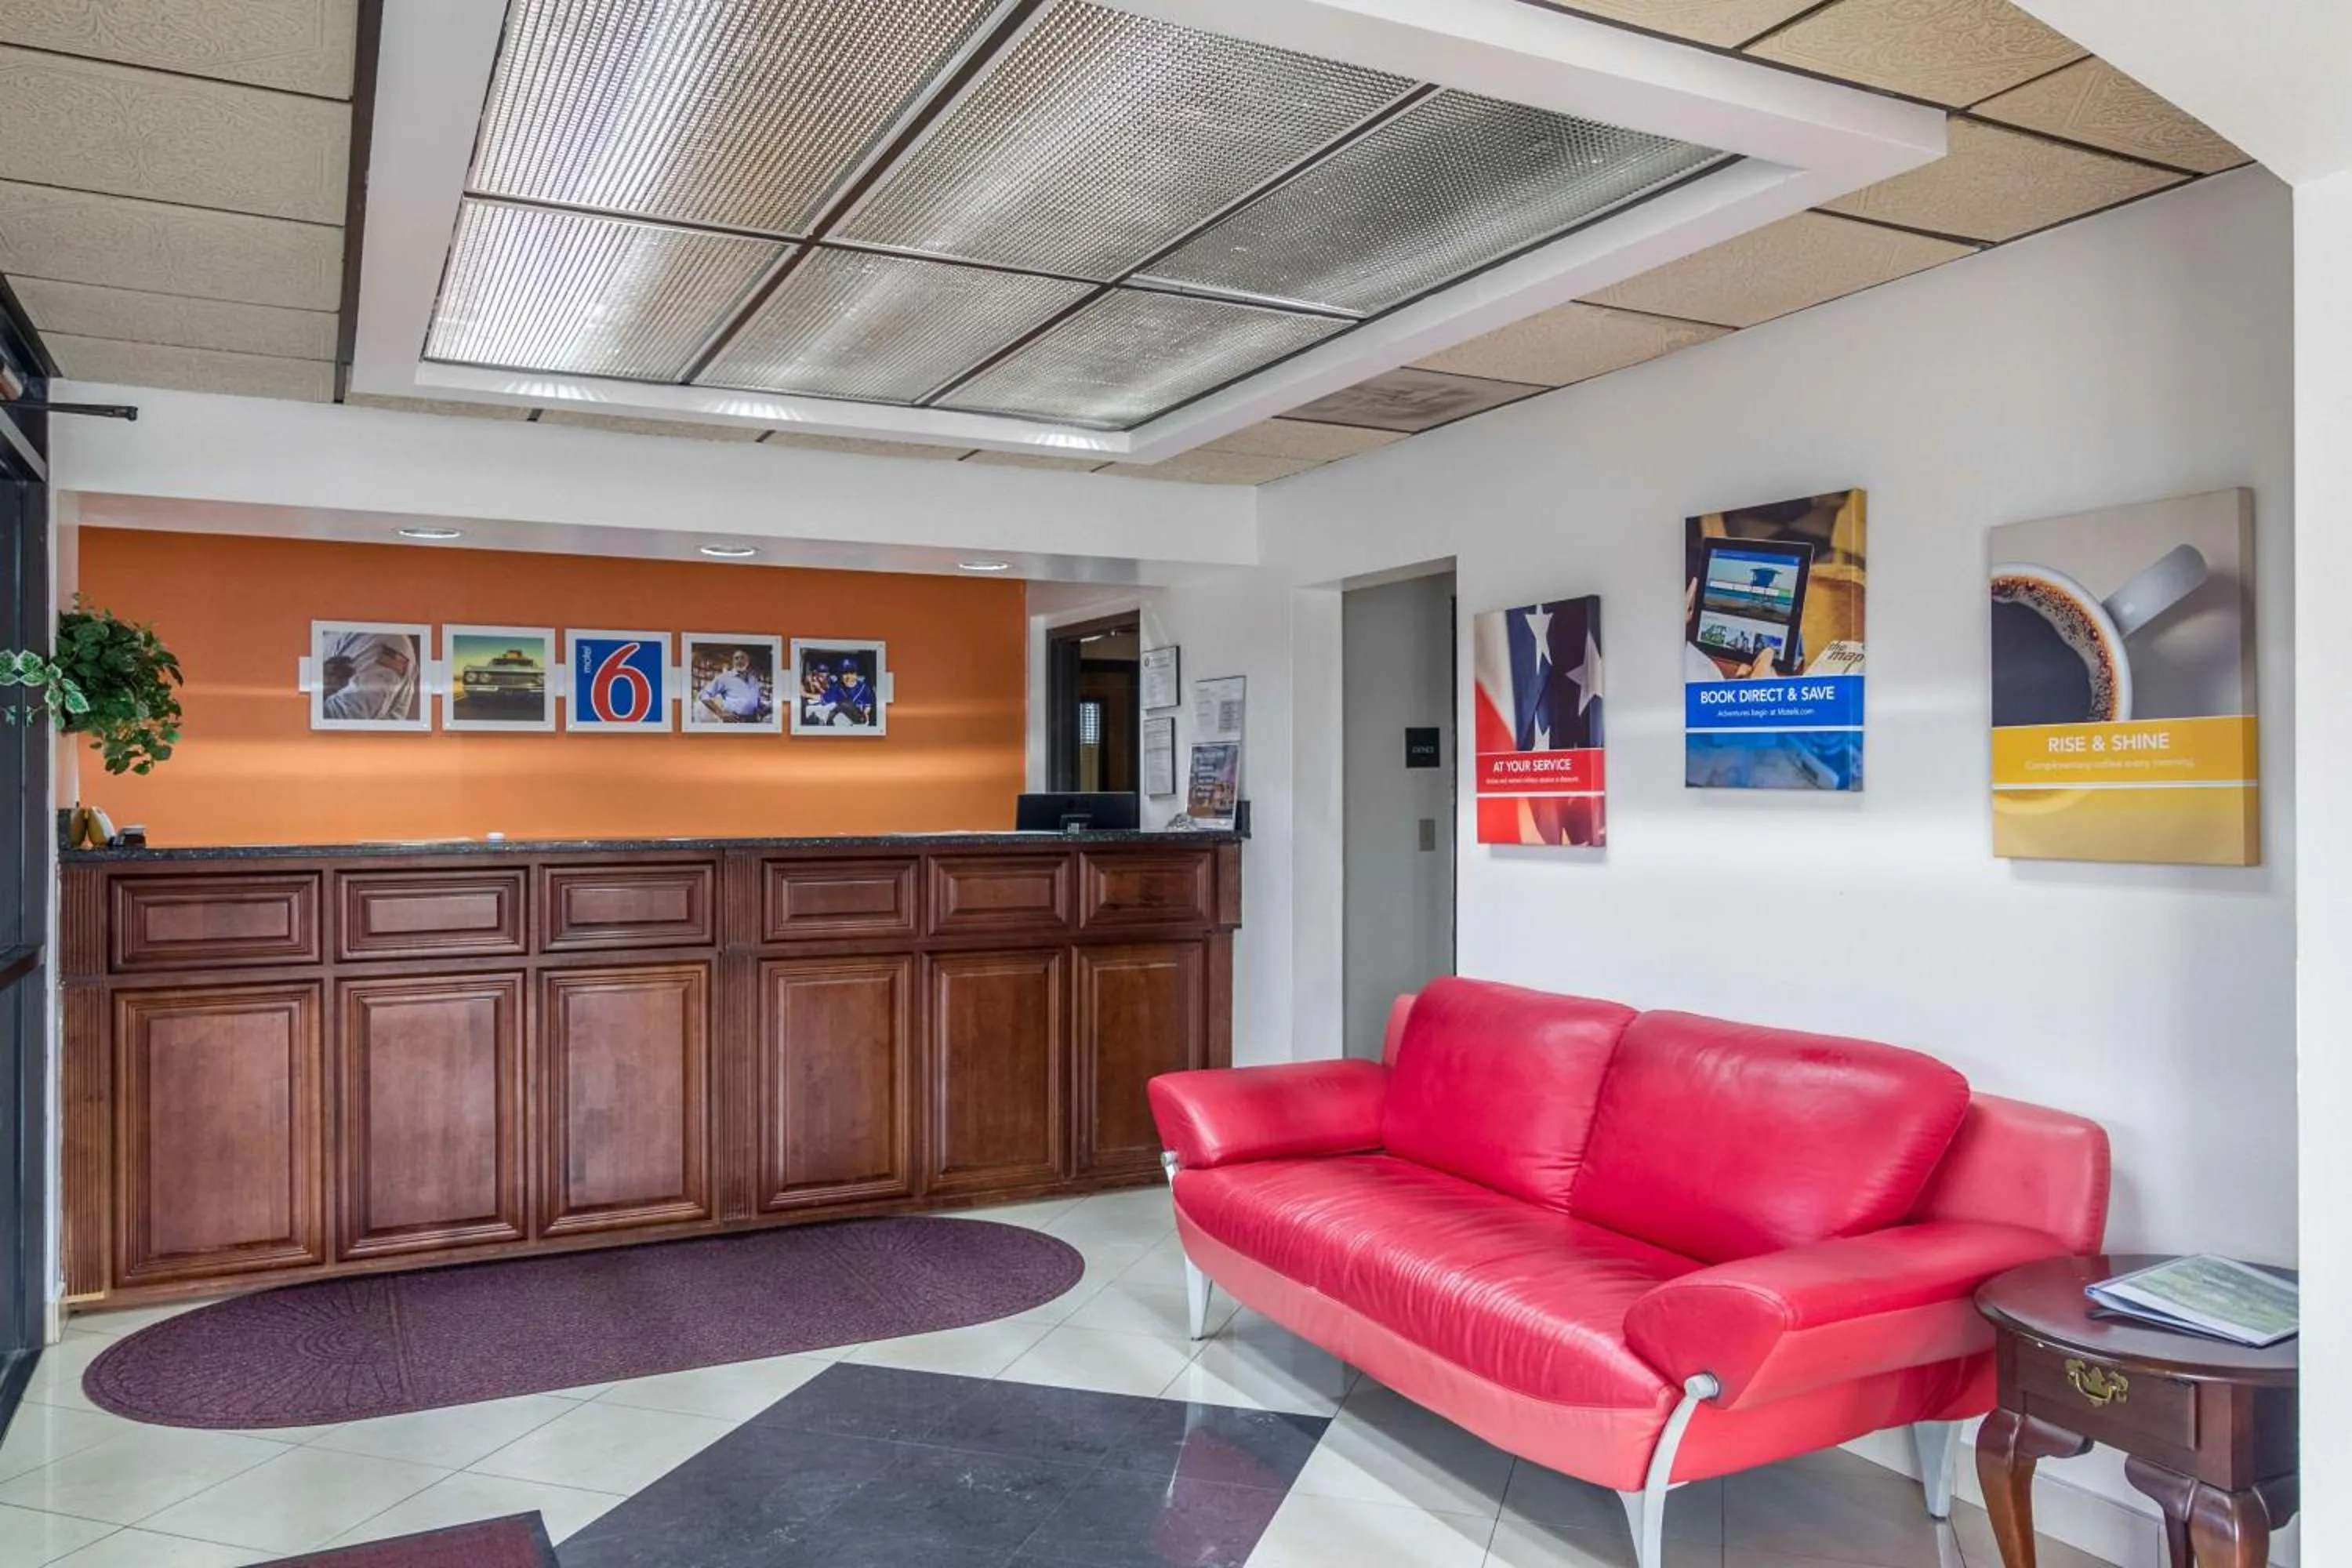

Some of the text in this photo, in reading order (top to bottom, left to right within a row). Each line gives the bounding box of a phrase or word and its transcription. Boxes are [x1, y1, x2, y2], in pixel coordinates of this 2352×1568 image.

[582, 645, 592, 673] motel
[1828, 652, 1864, 673] map
[591, 642, 652, 722] 6
[1700, 686, 1835, 704] BOOK DIRECT & SAVE
[2048, 731, 2171, 753] RISE & SHINE
[1493, 758, 1572, 772] AT YOUR SERVICE
